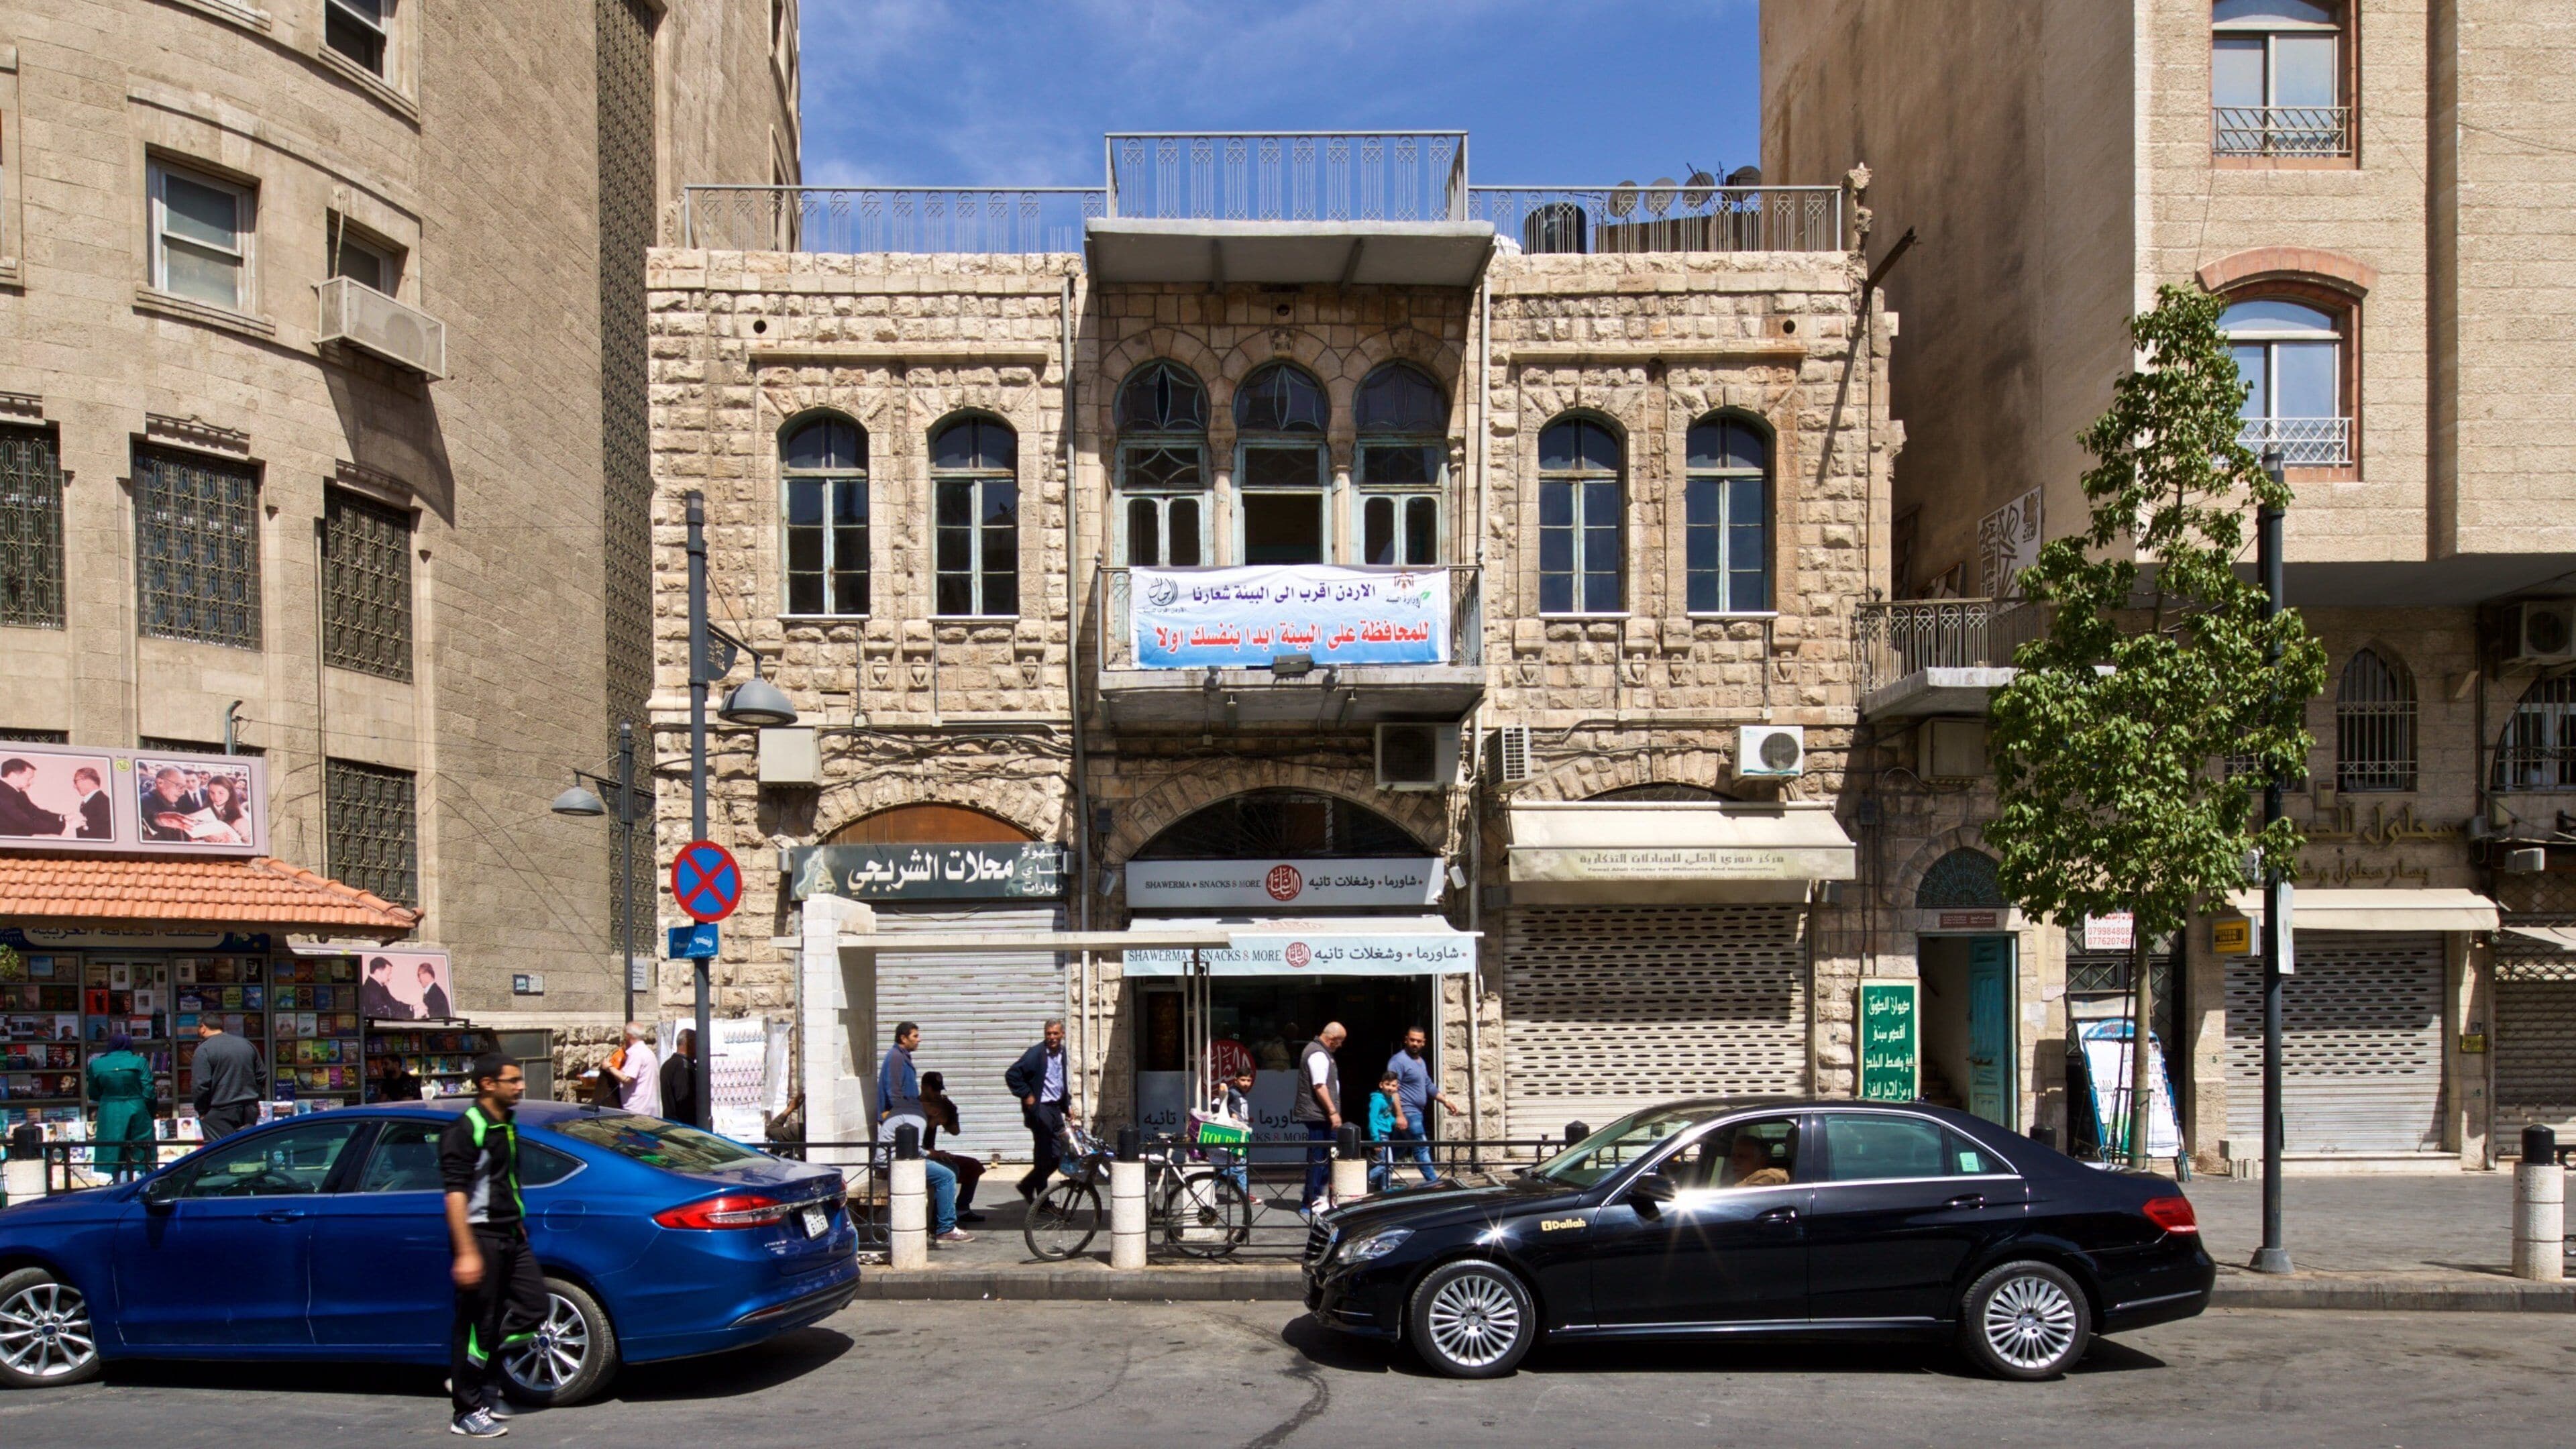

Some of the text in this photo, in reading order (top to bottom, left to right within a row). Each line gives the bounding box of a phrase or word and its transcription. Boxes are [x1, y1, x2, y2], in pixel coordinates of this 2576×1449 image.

[1193, 585, 1230, 604] شعارنا
[1299, 582, 1330, 602] اقرب
[1336, 583, 1375, 601] الاردن
[1156, 620, 1429, 652] للمحافظة على البيئة ابدا بنفسك اولا
[1022, 845, 1062, 860] قهوة
[1685, 853, 1716, 865] العلي
[1721, 853, 1752, 865] فوزي
[1759, 853, 1784, 864] مركز
[847, 848, 1014, 896] محلات الشربجي
[1022, 864, 1062, 879] شاي
[1022, 881, 1063, 895] بهارات
[1145, 880, 1191, 889] SHAWERMA
[1199, 880, 1230, 888] SNACKS
[1239, 879, 1261, 888] MORE
[1308, 875, 1417, 890] شاورما وشغلات تانيه
[2088, 927, 2131, 935] 079984808
[1128, 949, 1188, 962] SHAWERMA
[1199, 949, 1241, 962] SNACKS
[1252, 949, 1281, 962] MORE
[1314, 947, 1343, 963] تانيه
[1349, 947, 1403, 962] وشغلات
[1417, 946, 1459, 962] شاورما
[1868, 996, 1910, 1016] ديوان الدوق
[1873, 1022, 1906, 1042] أقدم مبنى
[1866, 1053, 1915, 1073] في وسط البلد
[1284, 1132, 1308, 1142] MOR
[1552, 1218, 1587, 1230] Dallah
